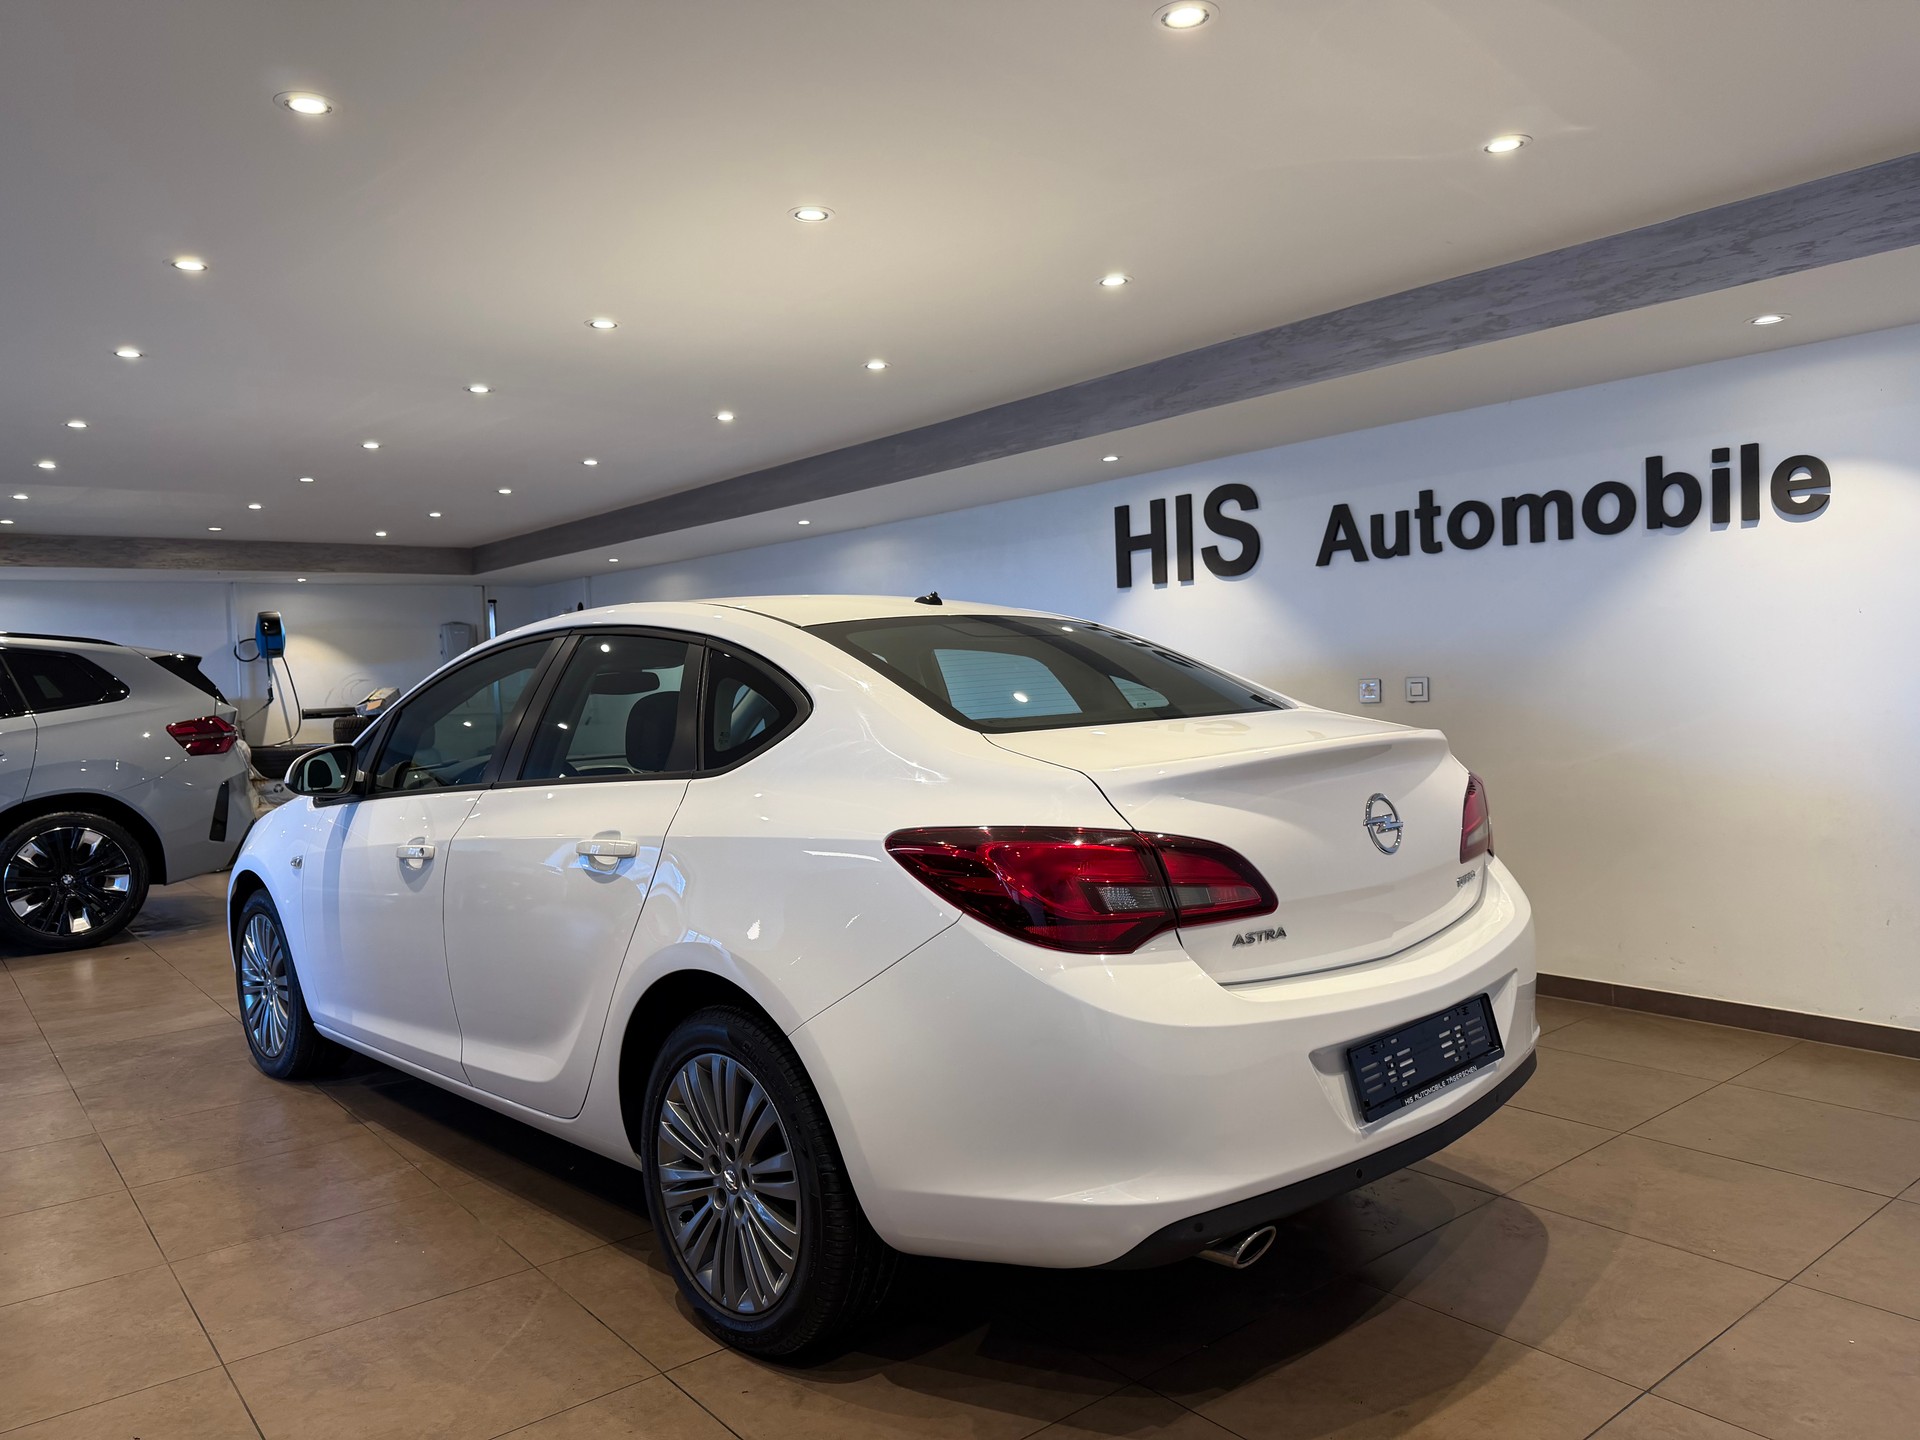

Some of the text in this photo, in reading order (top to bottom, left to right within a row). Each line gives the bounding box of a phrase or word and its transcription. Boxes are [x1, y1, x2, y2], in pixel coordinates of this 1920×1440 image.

[1114, 443, 1831, 588] HIS Automobile
[1232, 927, 1287, 946] ASTRA
[1404, 1096, 1414, 1106] HIS
[1415, 1081, 1446, 1099] AUTOMOBILE
